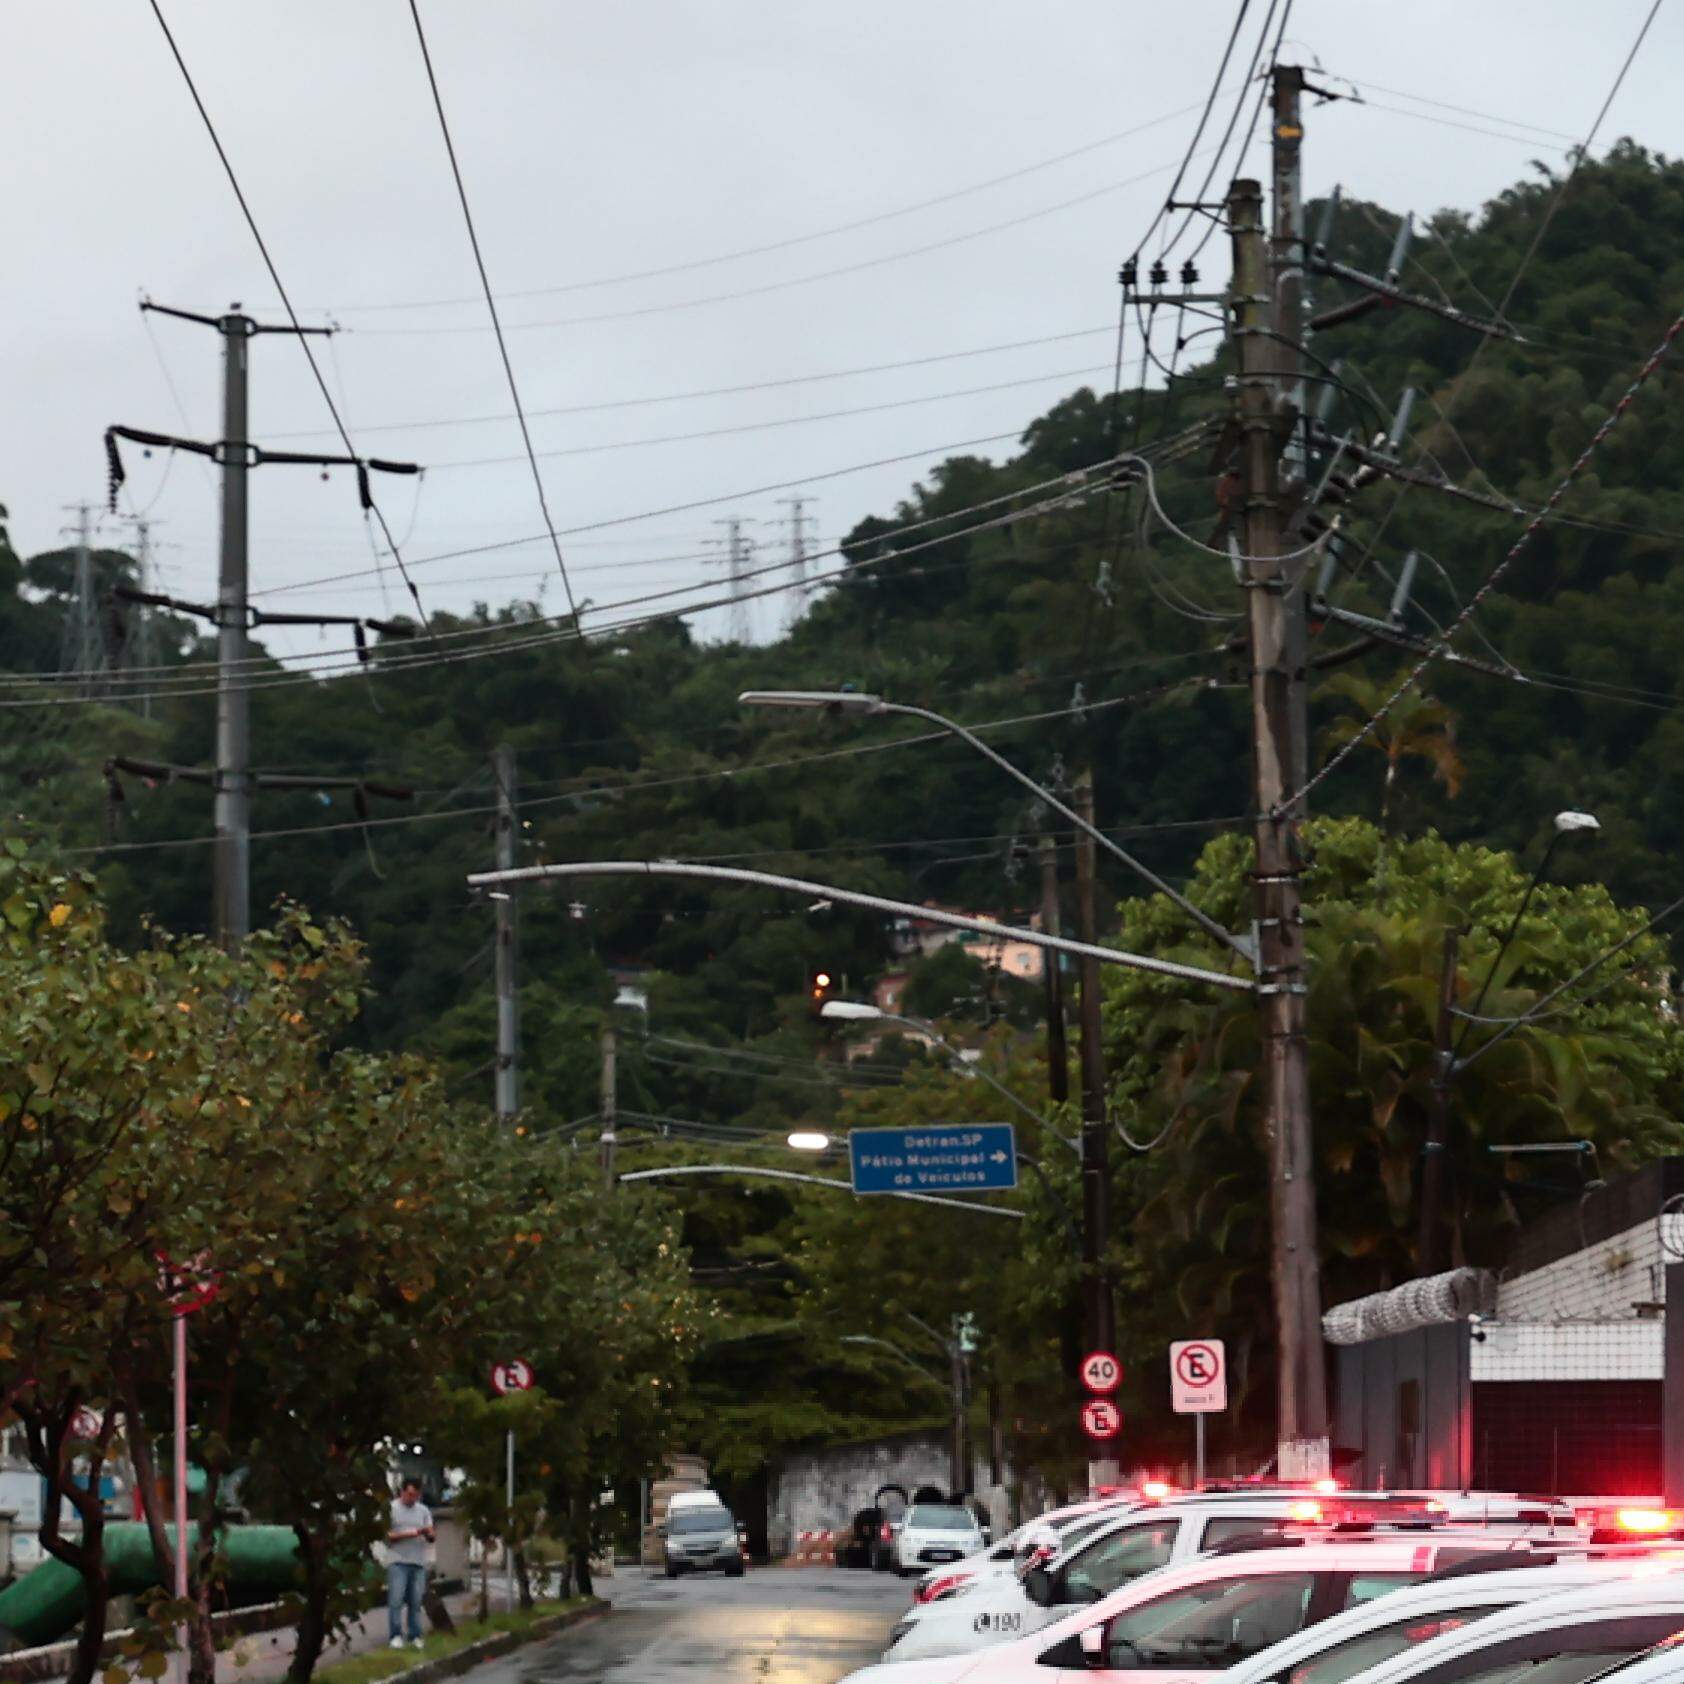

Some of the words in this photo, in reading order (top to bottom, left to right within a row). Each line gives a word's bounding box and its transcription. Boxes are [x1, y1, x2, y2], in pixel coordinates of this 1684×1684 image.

[907, 1152, 984, 1166] Municipal
[895, 1171, 912, 1184] de
[1088, 1361, 1114, 1378] 40
